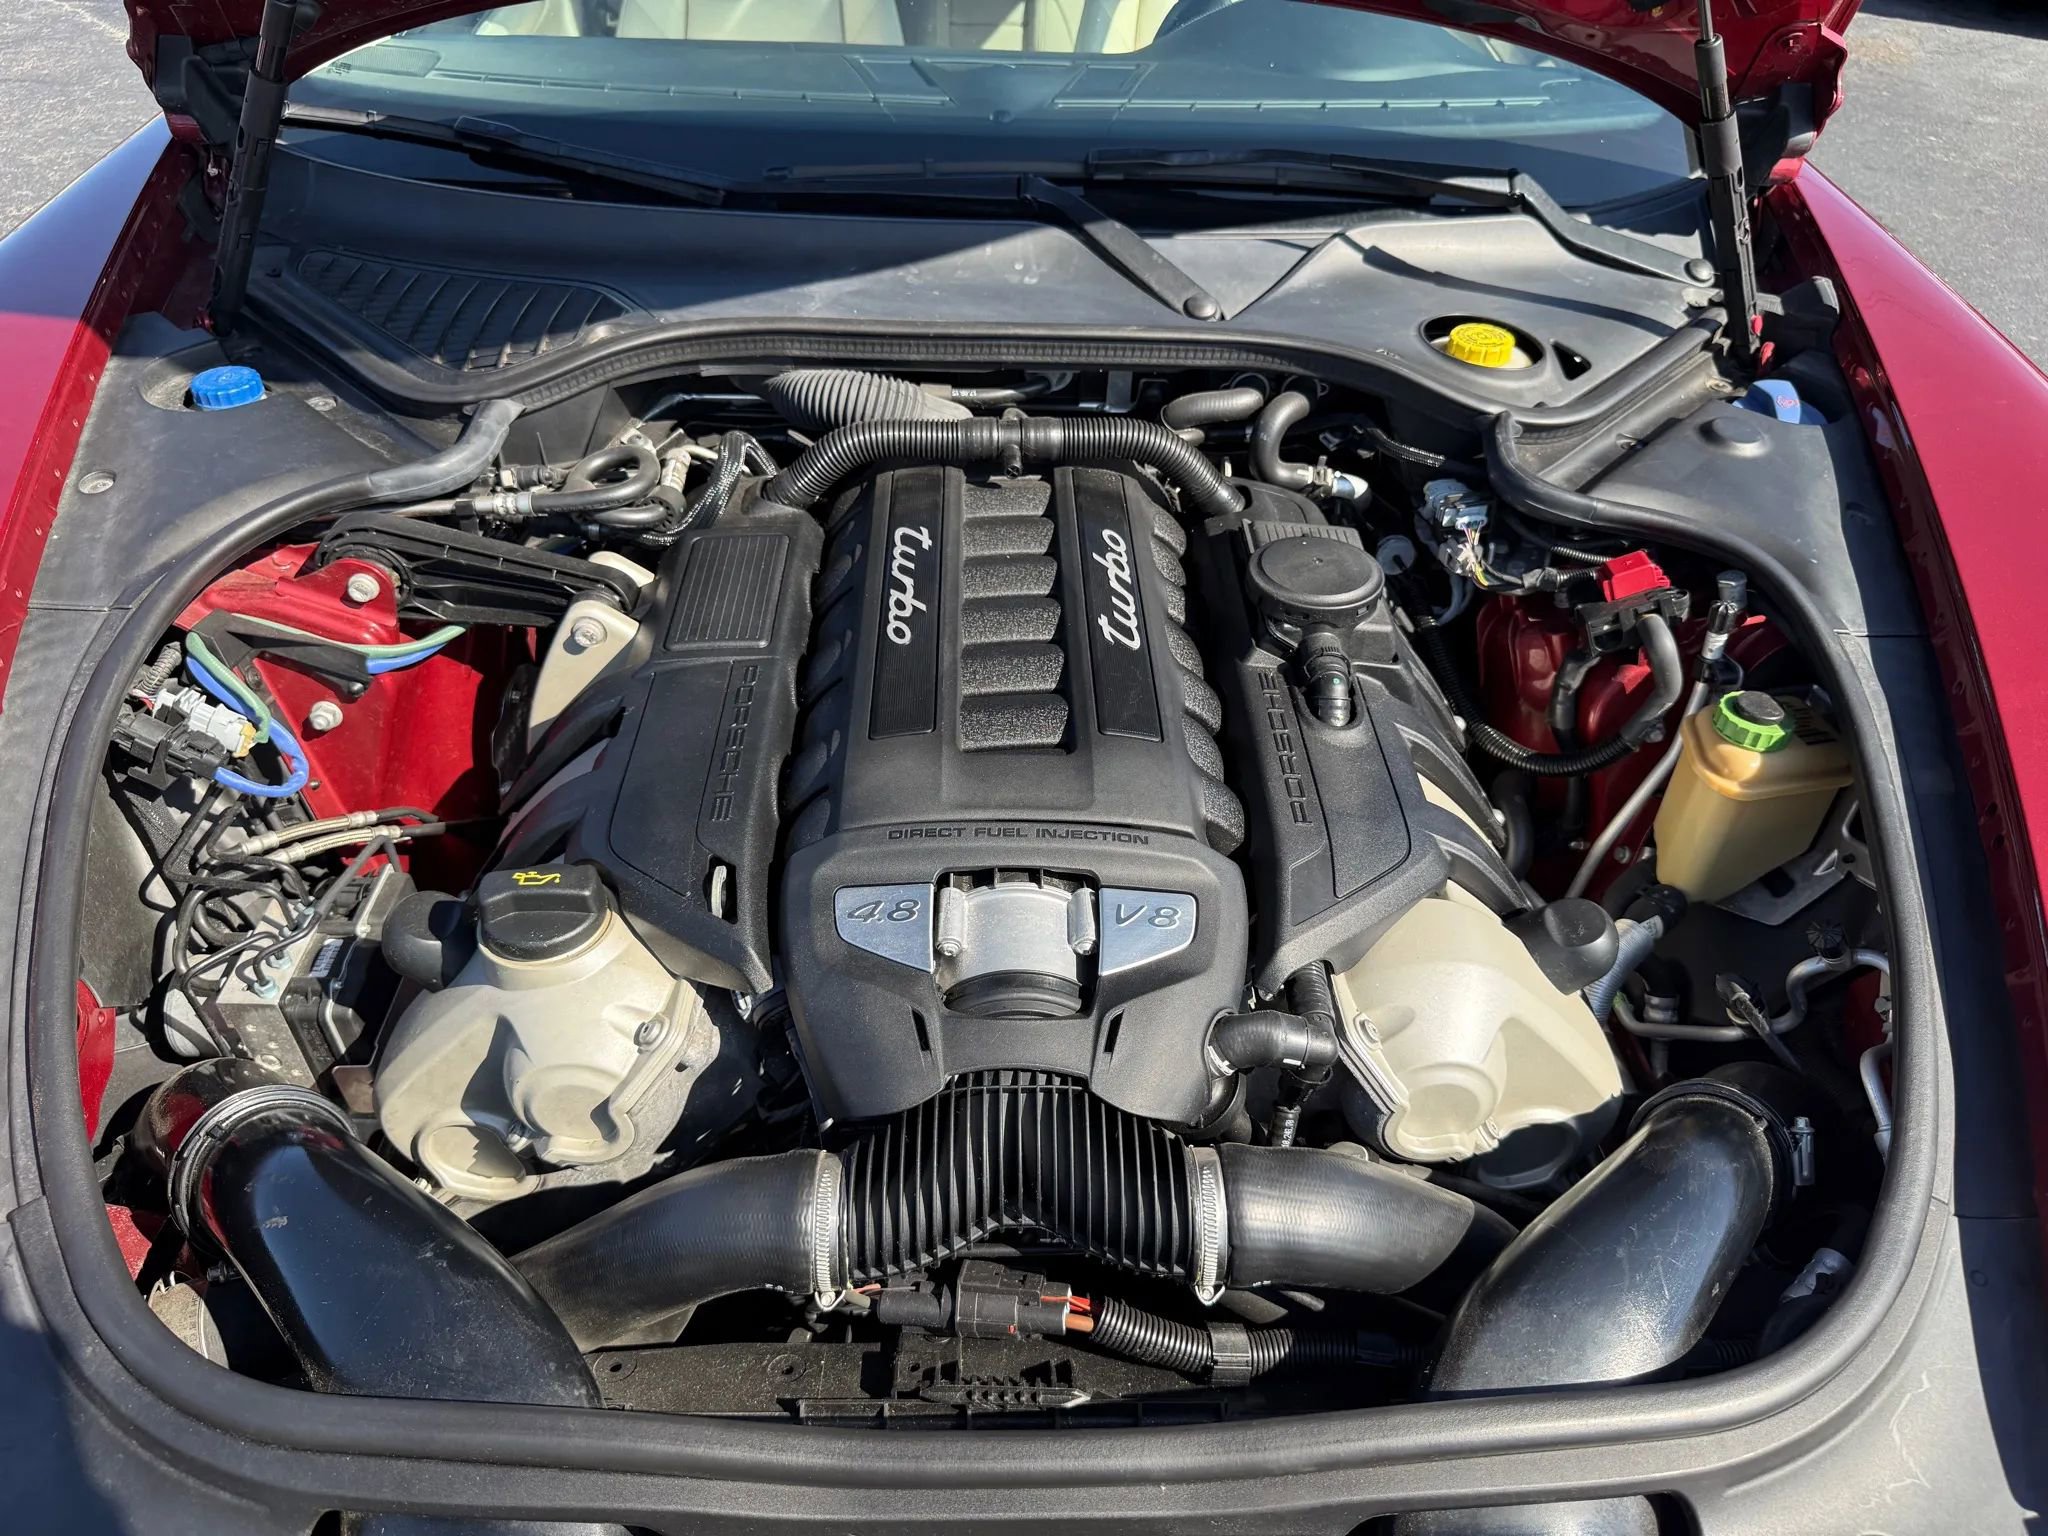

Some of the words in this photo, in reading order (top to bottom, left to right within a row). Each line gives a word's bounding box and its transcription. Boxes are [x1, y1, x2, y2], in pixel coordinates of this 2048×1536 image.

[886, 525, 933, 645] turbo
[1092, 528, 1141, 651] turbo
[710, 665, 759, 822] PORSCHE
[1258, 672, 1313, 826] PORSCHE
[887, 827, 967, 840] DIRECT
[973, 827, 1028, 838] FUEL
[1035, 827, 1149, 846] INJECTION
[846, 898, 922, 924] 4.8
[1114, 902, 1183, 931] V8
